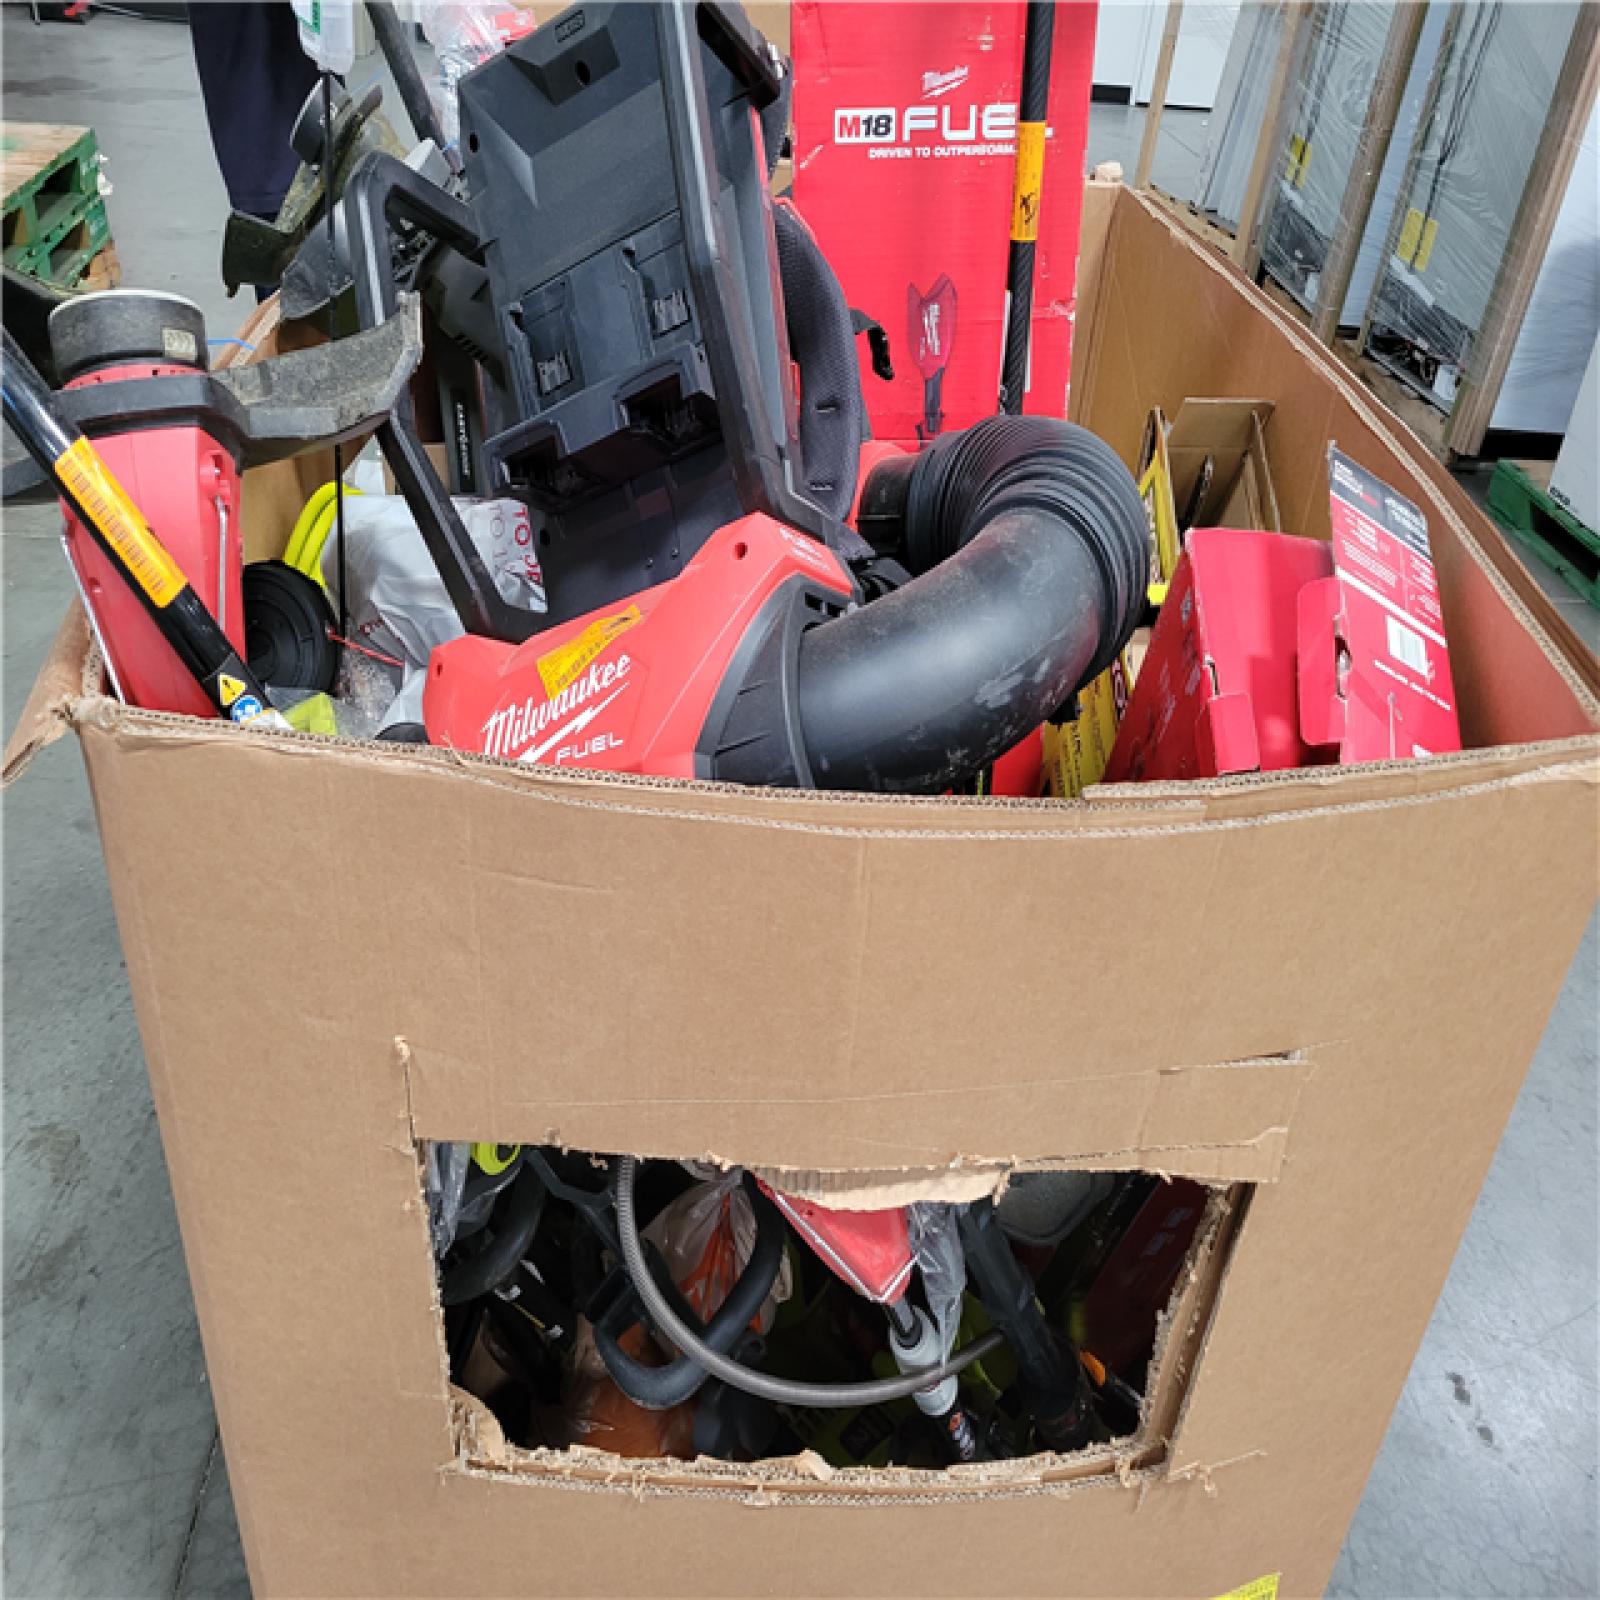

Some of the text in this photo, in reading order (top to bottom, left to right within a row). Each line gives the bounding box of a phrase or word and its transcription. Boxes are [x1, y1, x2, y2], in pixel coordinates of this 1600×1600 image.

[838, 103, 1053, 142] M18 FUE
[914, 147, 931, 158] TO
[480, 653, 632, 758] Milwaukee
[554, 731, 624, 766] FUEL
